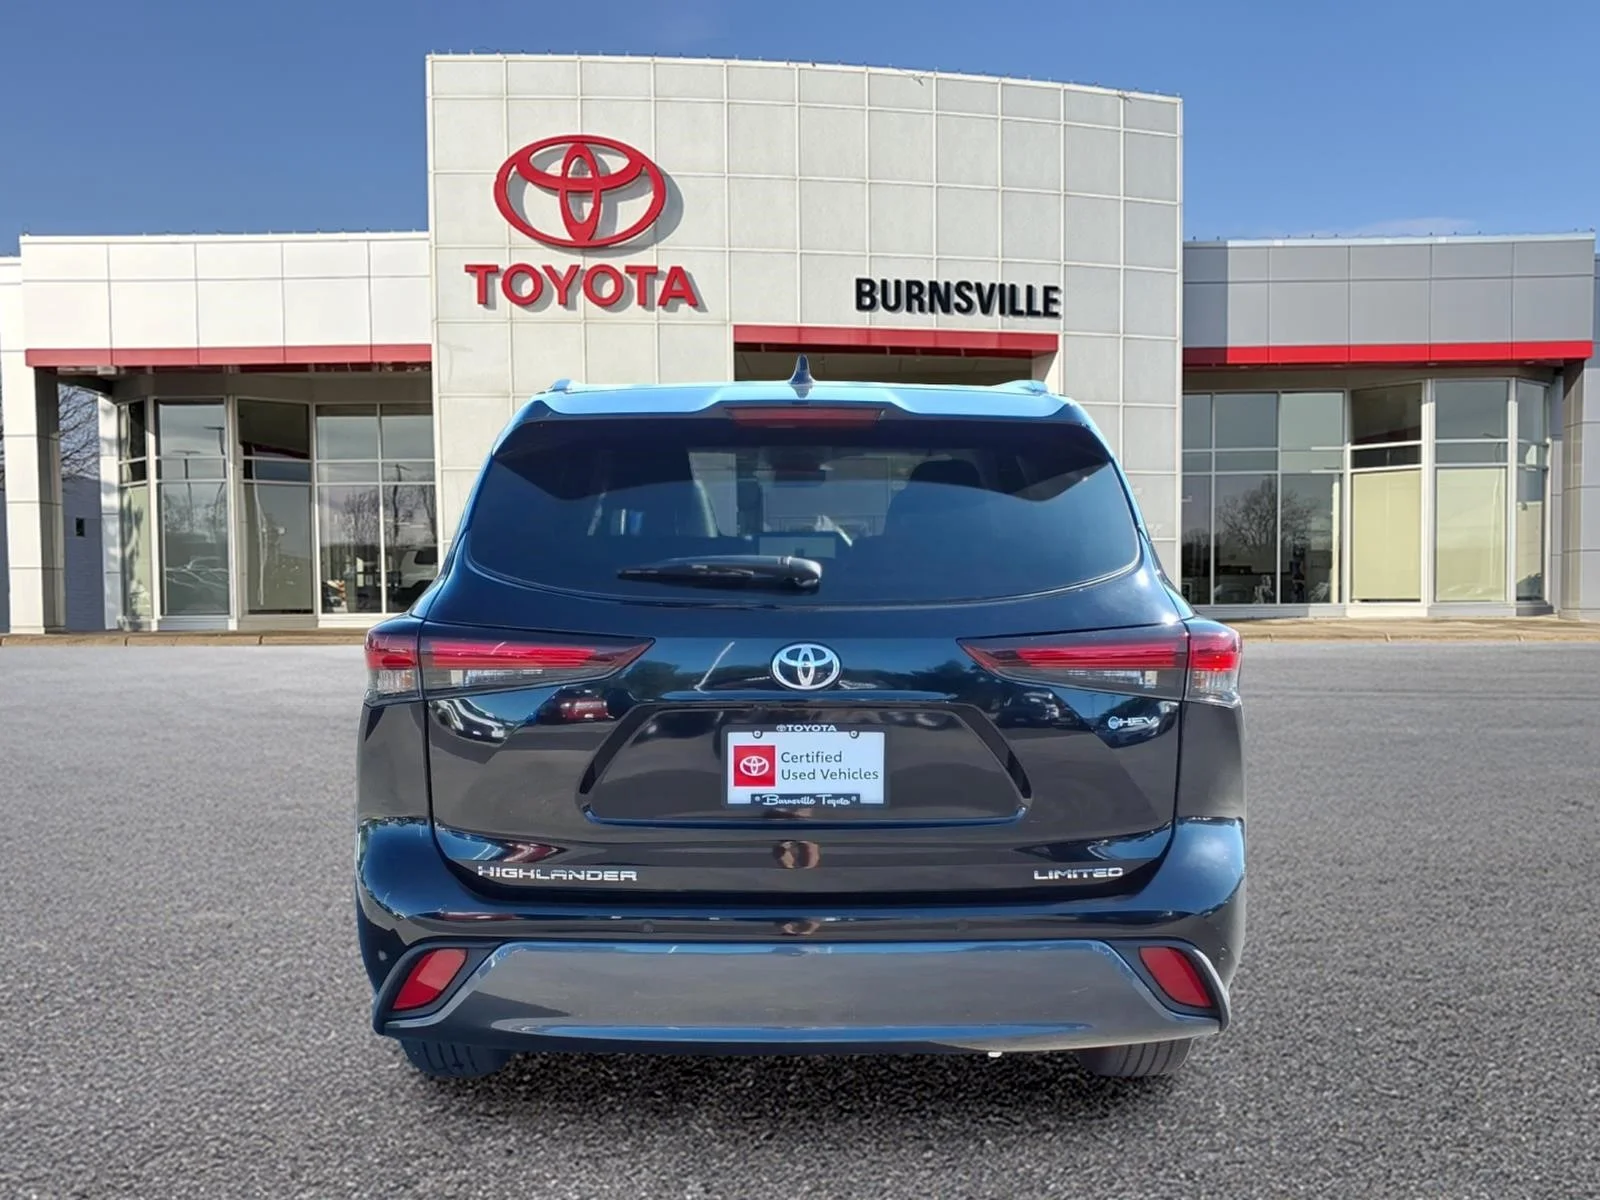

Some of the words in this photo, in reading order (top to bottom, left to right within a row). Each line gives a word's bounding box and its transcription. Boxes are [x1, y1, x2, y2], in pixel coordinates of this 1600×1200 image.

[465, 264, 698, 307] TOYOTA
[855, 277, 1061, 318] BURNSVILLE
[786, 724, 837, 732] TOYOTA
[781, 751, 842, 763] Certified
[781, 769, 816, 780] Used
[820, 768, 879, 780] Vehicles
[478, 866, 637, 881] HIGHLANDER
[1033, 867, 1124, 880] LIMITED
